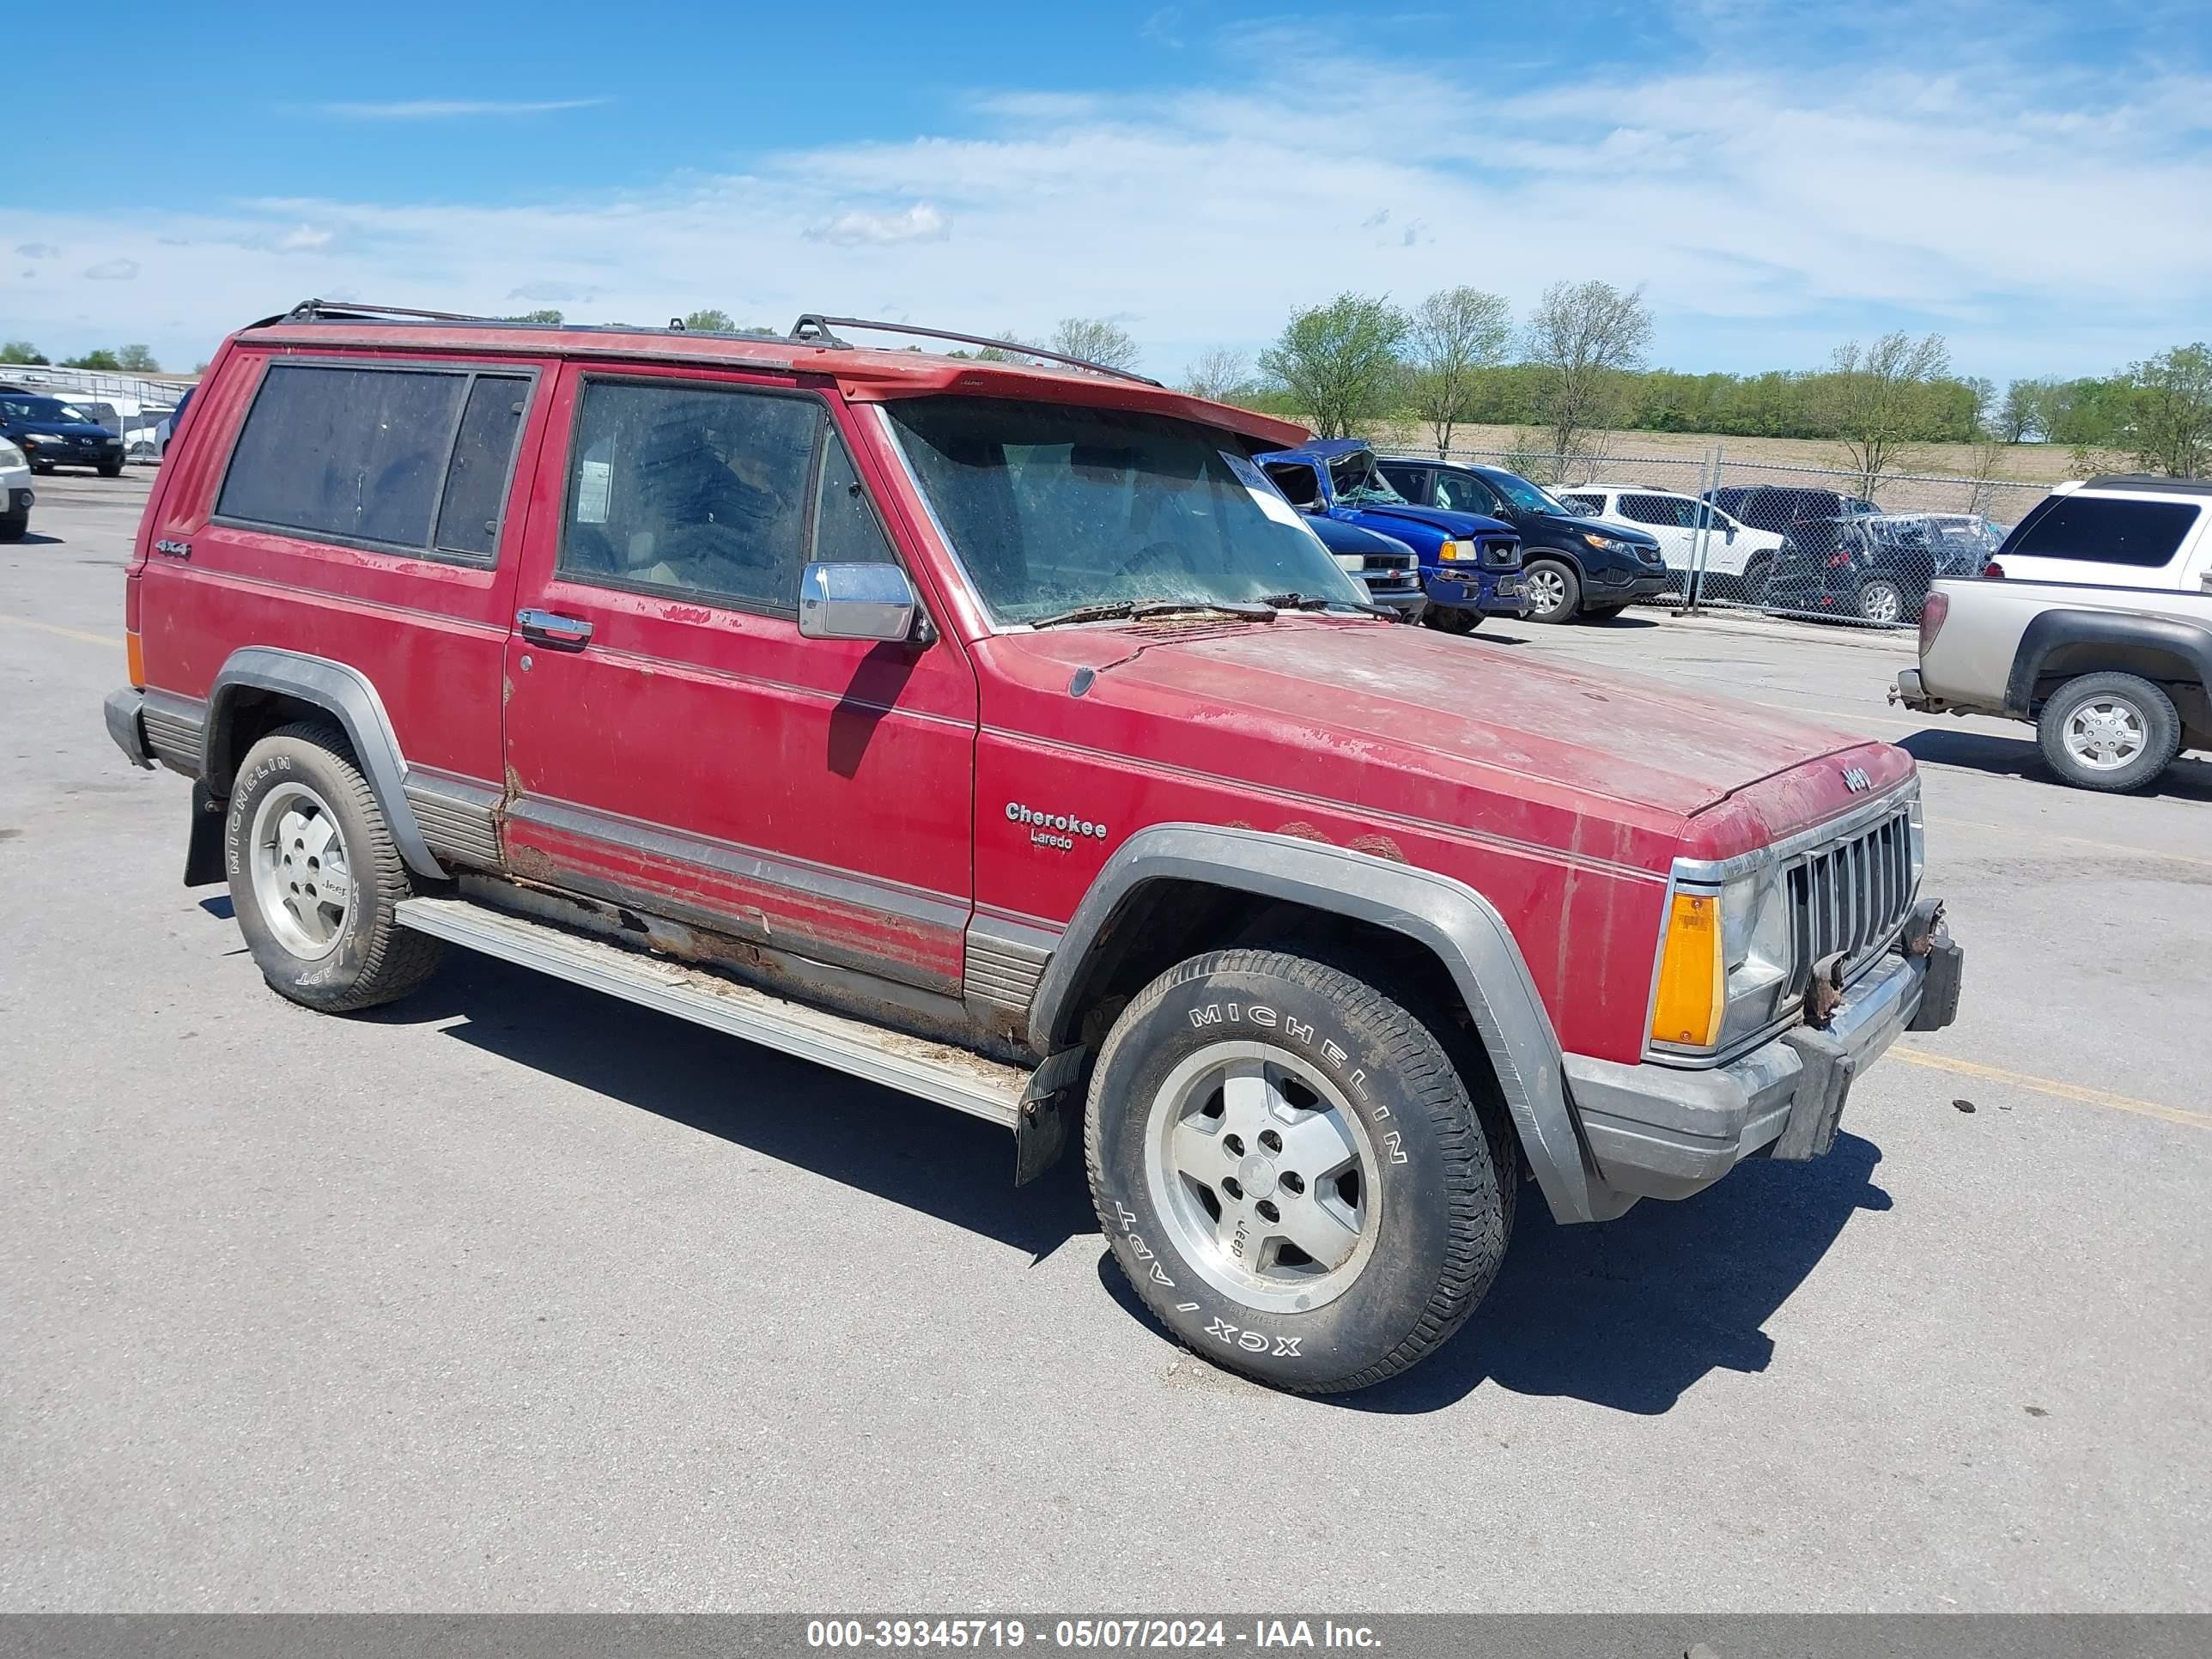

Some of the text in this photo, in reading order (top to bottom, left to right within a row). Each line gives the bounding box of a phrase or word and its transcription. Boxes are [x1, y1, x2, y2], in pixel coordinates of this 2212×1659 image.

[1840, 767, 1872, 792] Jeep
[229, 756, 291, 874] MICHELIN
[1006, 802, 1107, 838] Cherokee
[1030, 829, 1073, 849] Laredo
[1188, 1003, 1408, 1164] MICHELIN
[1115, 1201, 1175, 1287] APT
[1231, 1219, 1250, 1258] Jeep
[1203, 1316, 1304, 1358] XCX
